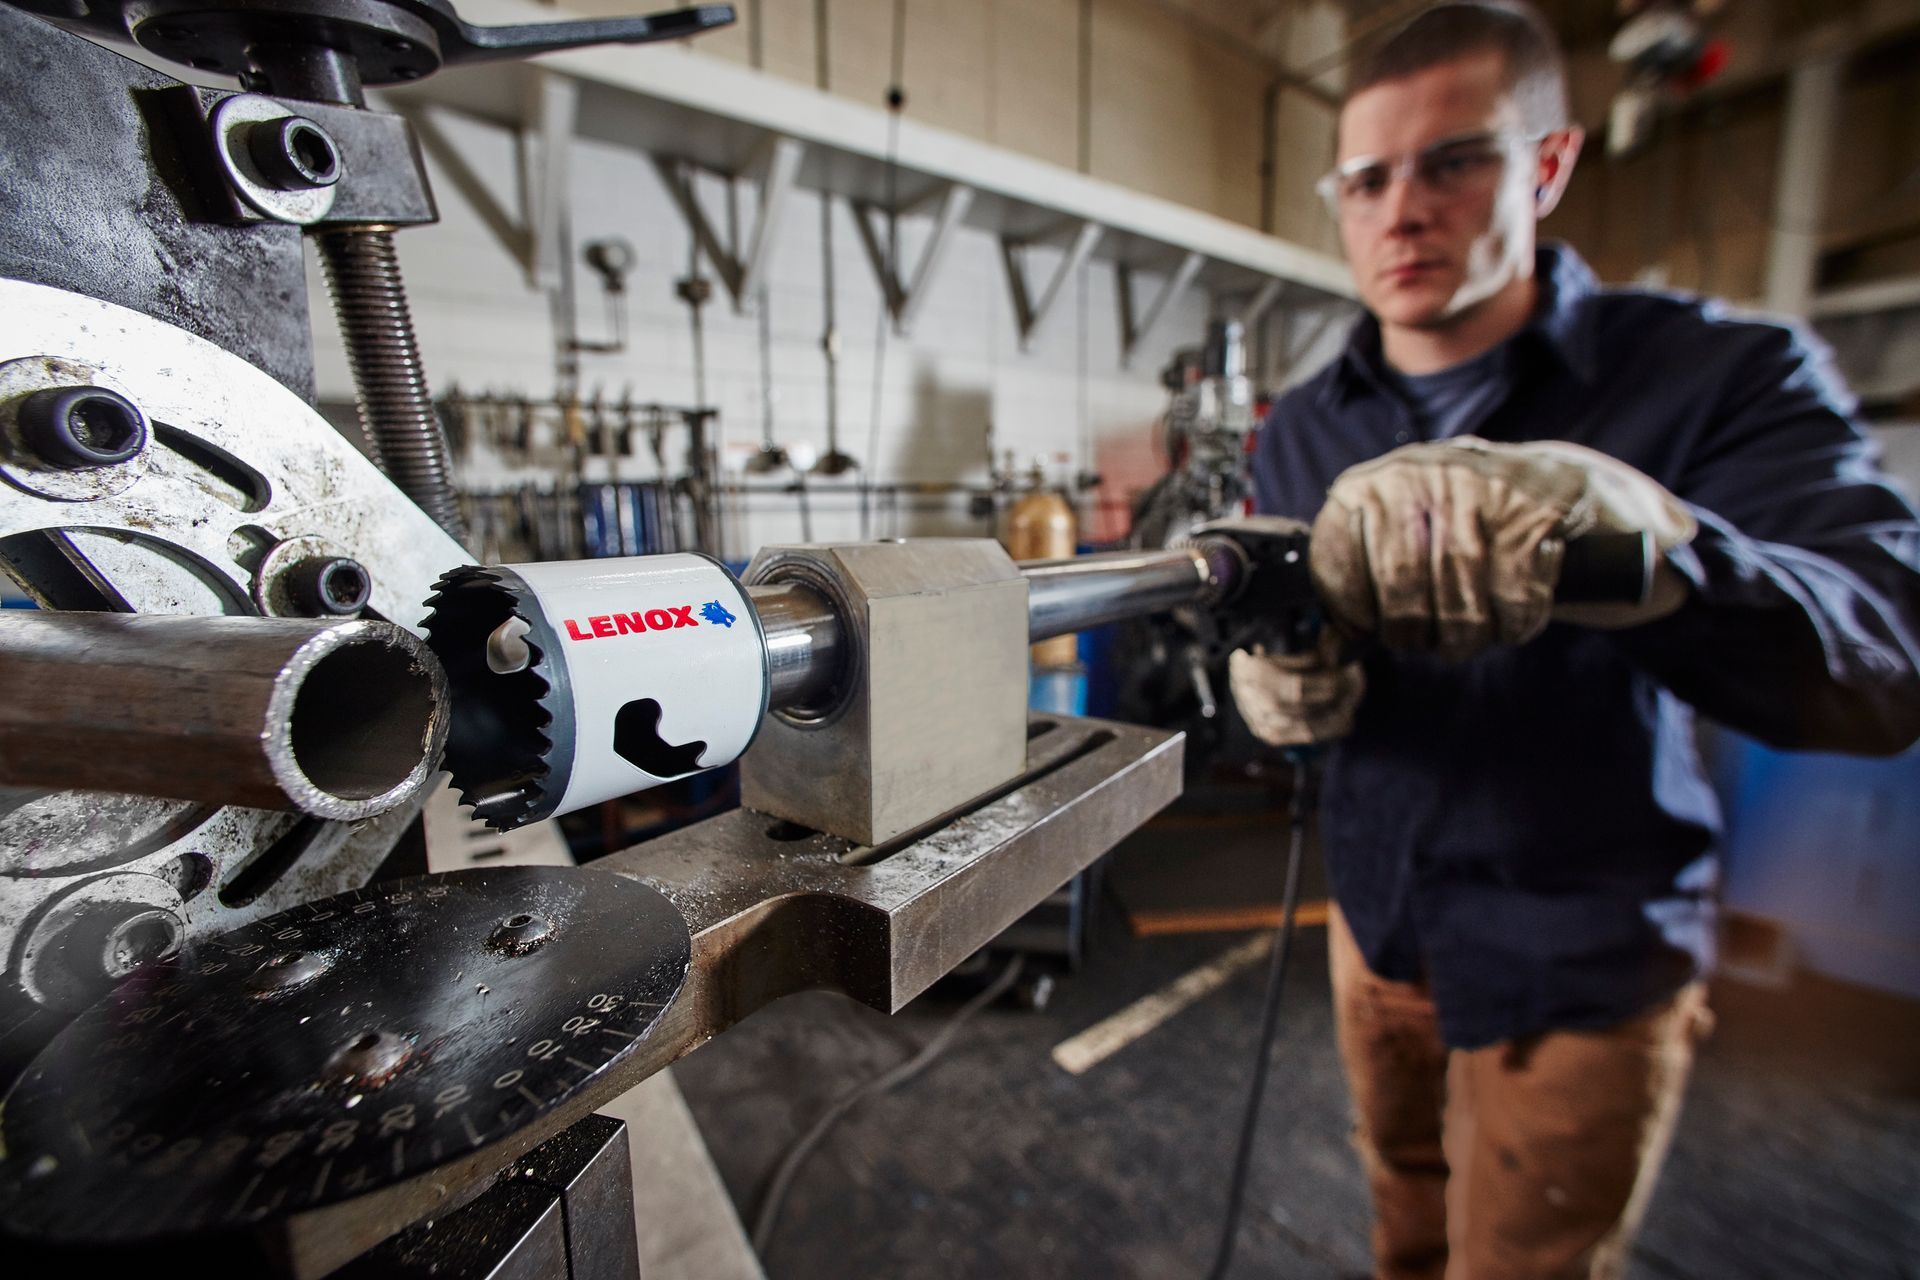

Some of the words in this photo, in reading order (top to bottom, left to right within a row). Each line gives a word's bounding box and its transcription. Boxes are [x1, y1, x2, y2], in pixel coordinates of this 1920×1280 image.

[564, 605, 699, 641] LENOX
[226, 944, 265, 957] 20
[587, 993, 624, 1013] 30
[561, 1015, 602, 1039] 20
[527, 1039, 563, 1061] 10
[493, 1069, 524, 1089] 0
